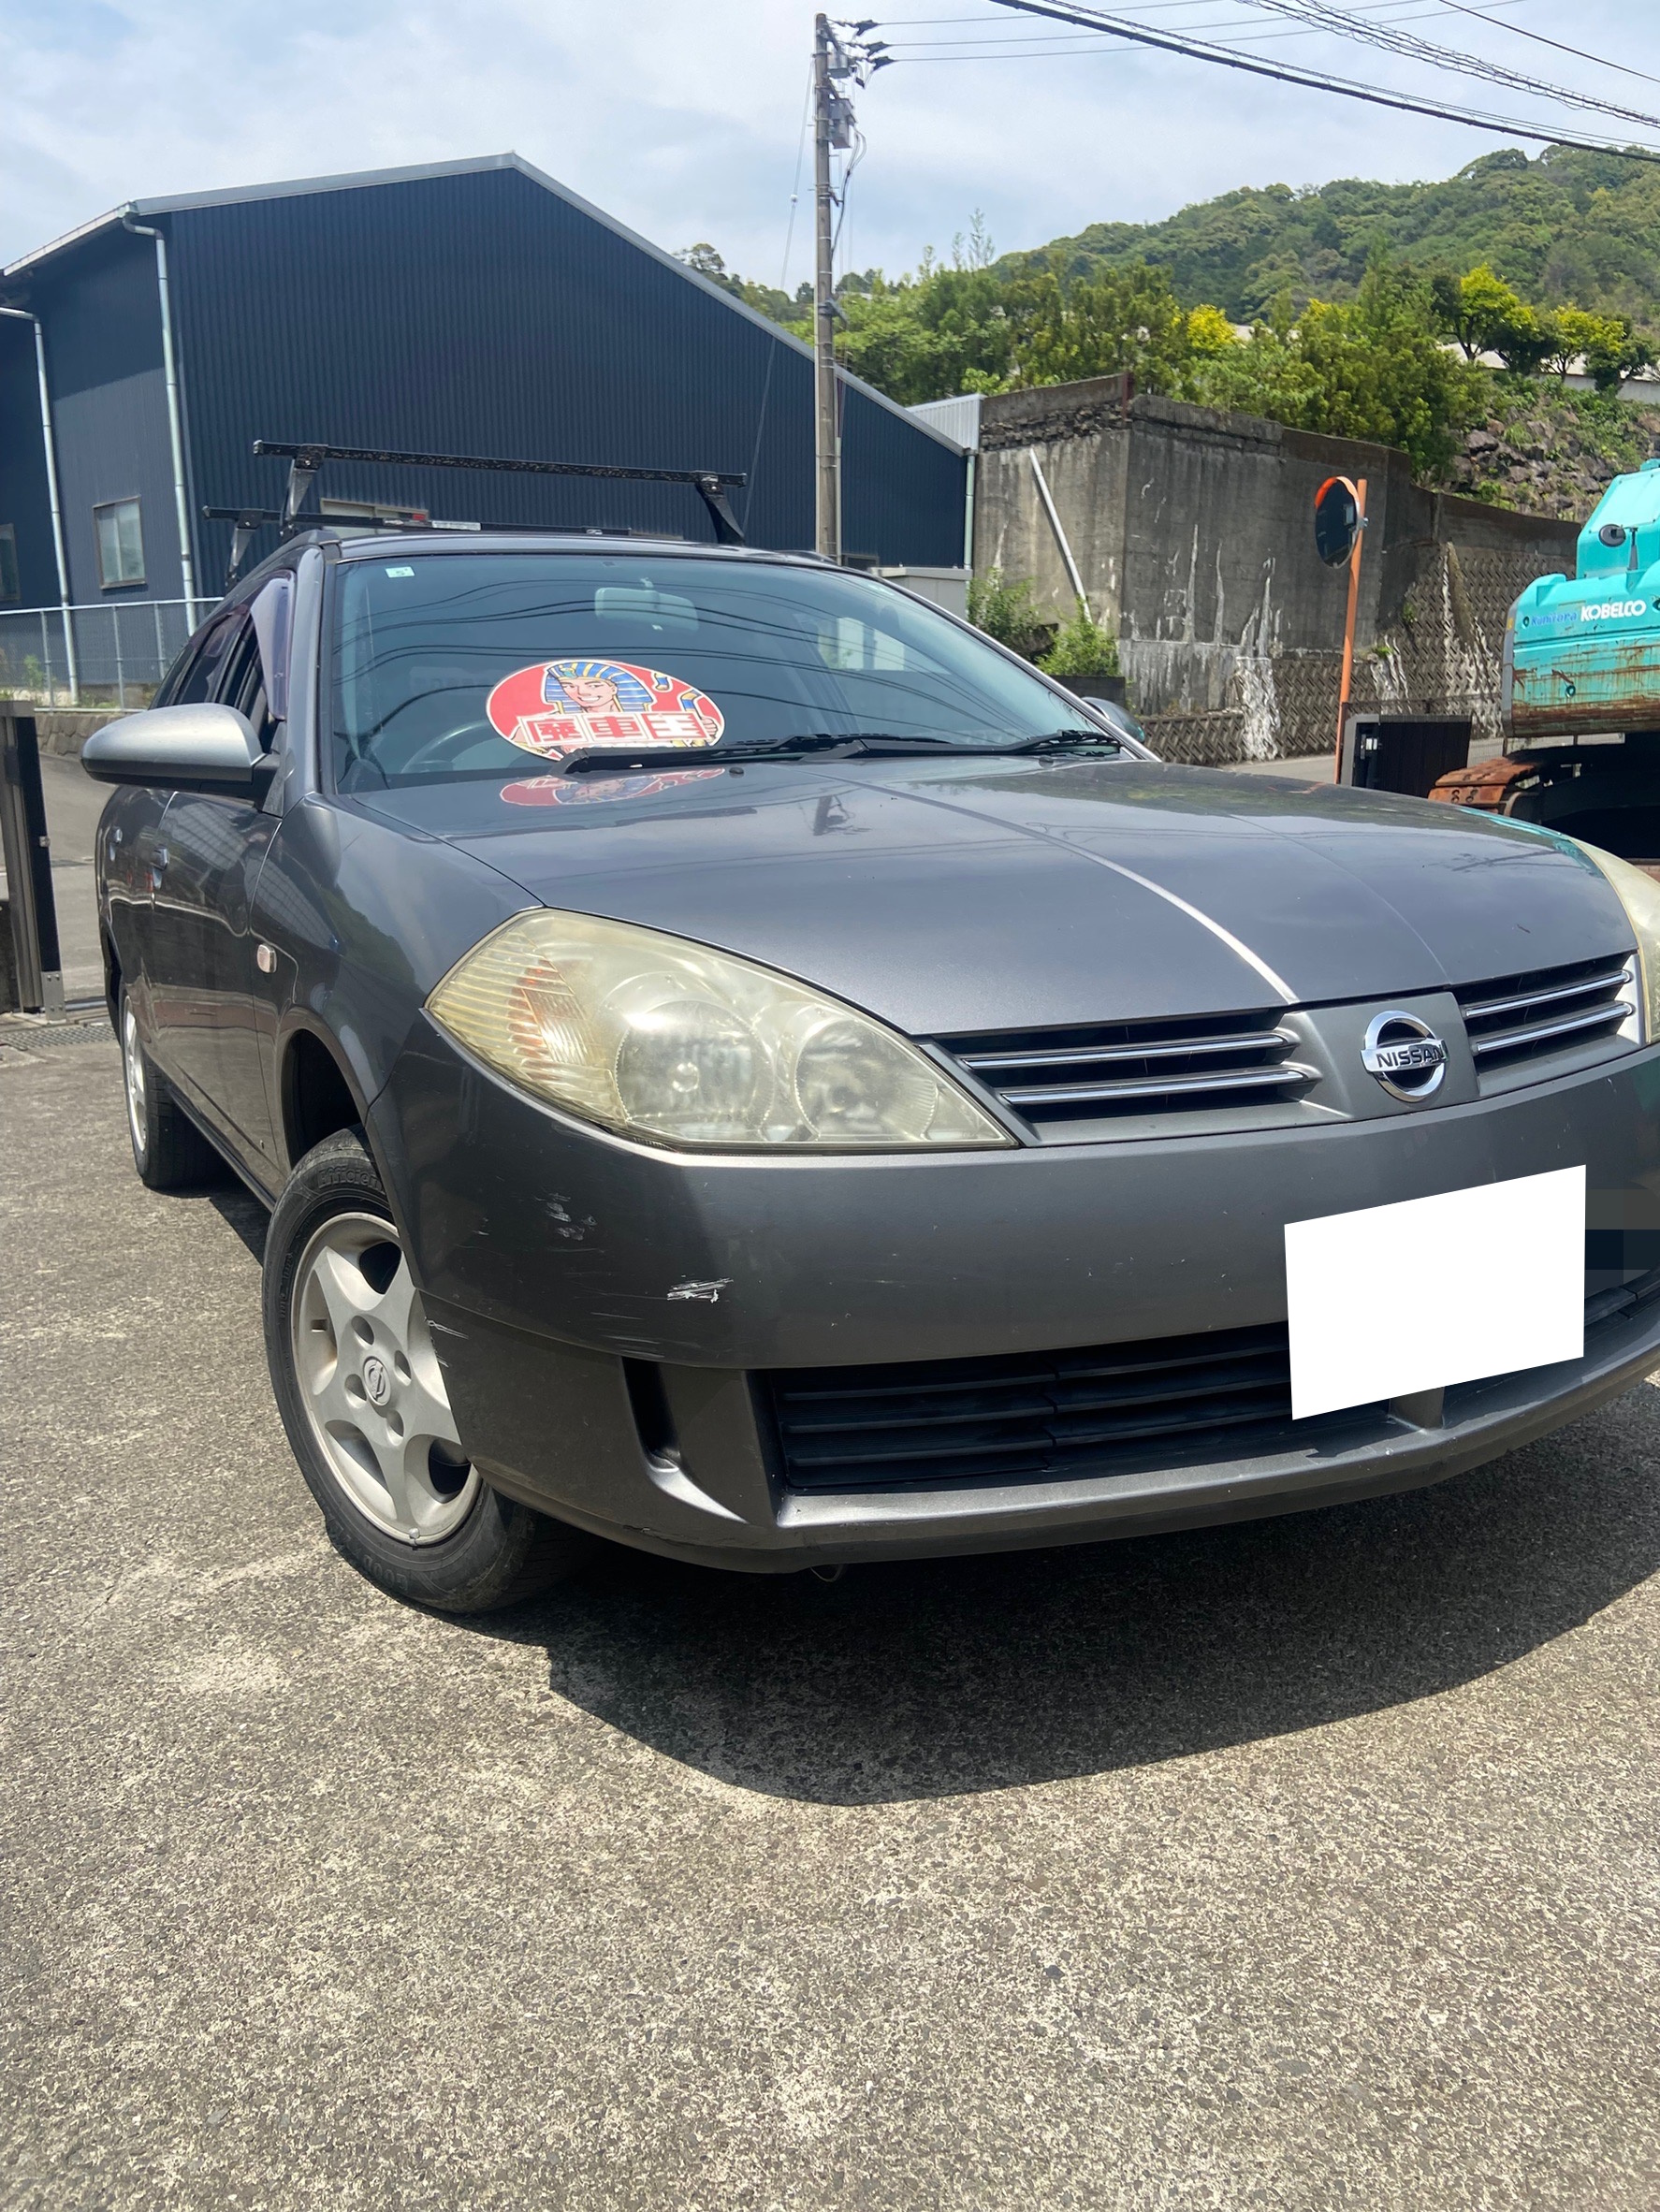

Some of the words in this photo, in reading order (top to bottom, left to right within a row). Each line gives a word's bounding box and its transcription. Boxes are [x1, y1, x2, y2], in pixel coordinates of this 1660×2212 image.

[1580, 600, 1647, 622] KOBELCO
[526, 712, 710, 745] 廃車王
[1376, 1046, 1446, 1069] NISSAN
